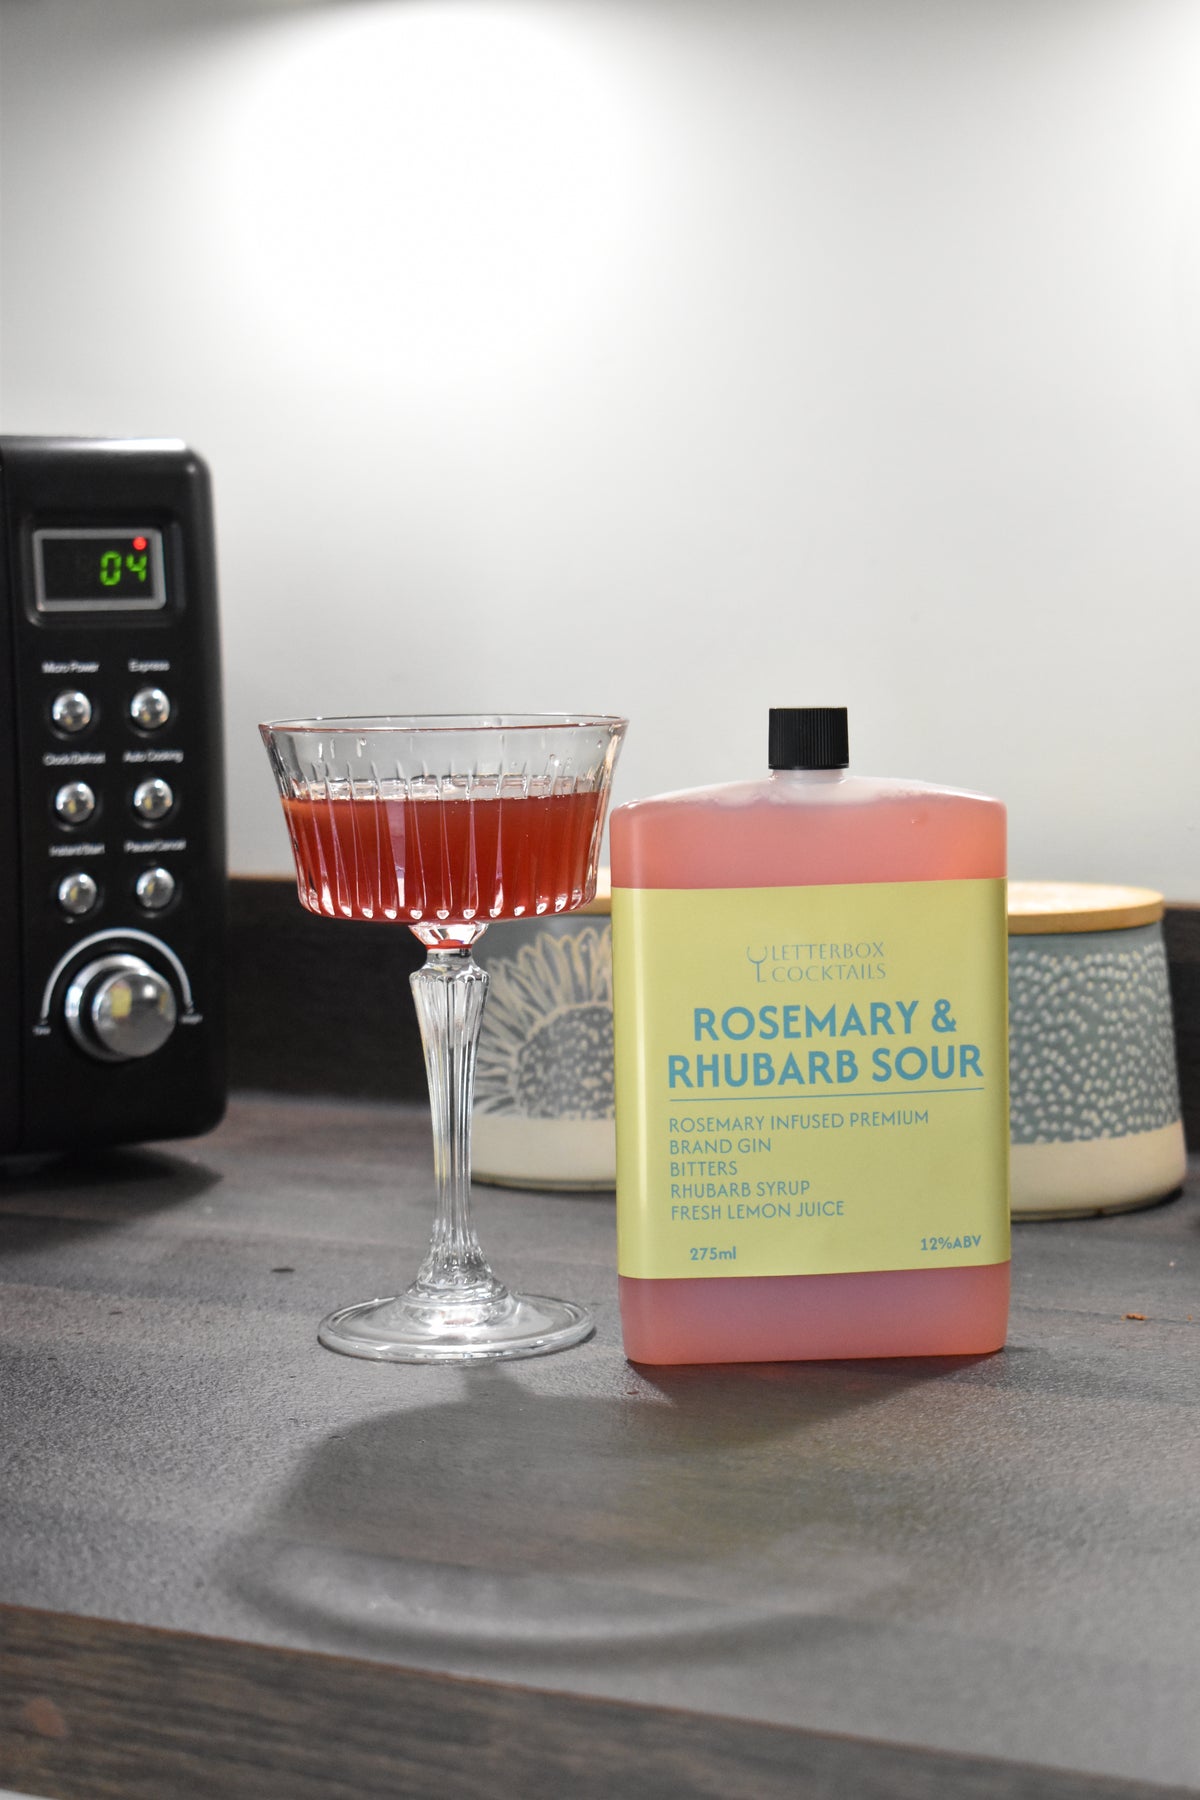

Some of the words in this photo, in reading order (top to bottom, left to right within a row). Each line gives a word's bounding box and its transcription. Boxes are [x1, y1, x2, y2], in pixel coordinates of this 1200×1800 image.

[99, 550, 147, 586] 04
[70, 661, 100, 673] Power
[128, 658, 170, 673] Express
[771, 941, 885, 962] LETTERBOX
[771, 962, 887, 983] COCKTAILS
[693, 1000, 920, 1042] ROSEMARY
[931, 998, 957, 1034] &
[668, 1049, 859, 1089] RHUBARB
[871, 1044, 985, 1082] SOUR
[669, 1115, 765, 1134] ROSEMARY
[770, 1112, 844, 1131] INFUSED
[849, 1110, 929, 1128] PREMIUM
[669, 1138, 733, 1156] BRAND
[737, 1137, 772, 1154] GIN
[670, 1161, 738, 1178] BITTERS
[670, 1182, 751, 1199] RHUBARB
[756, 1180, 811, 1197] SYRUP
[671, 1204, 722, 1221] FRESH
[727, 1203, 791, 1220] LEMON
[795, 1200, 845, 1217] JUICE
[920, 1234, 982, 1252] 12%ABV
[689, 1246, 737, 1261] 275ml
